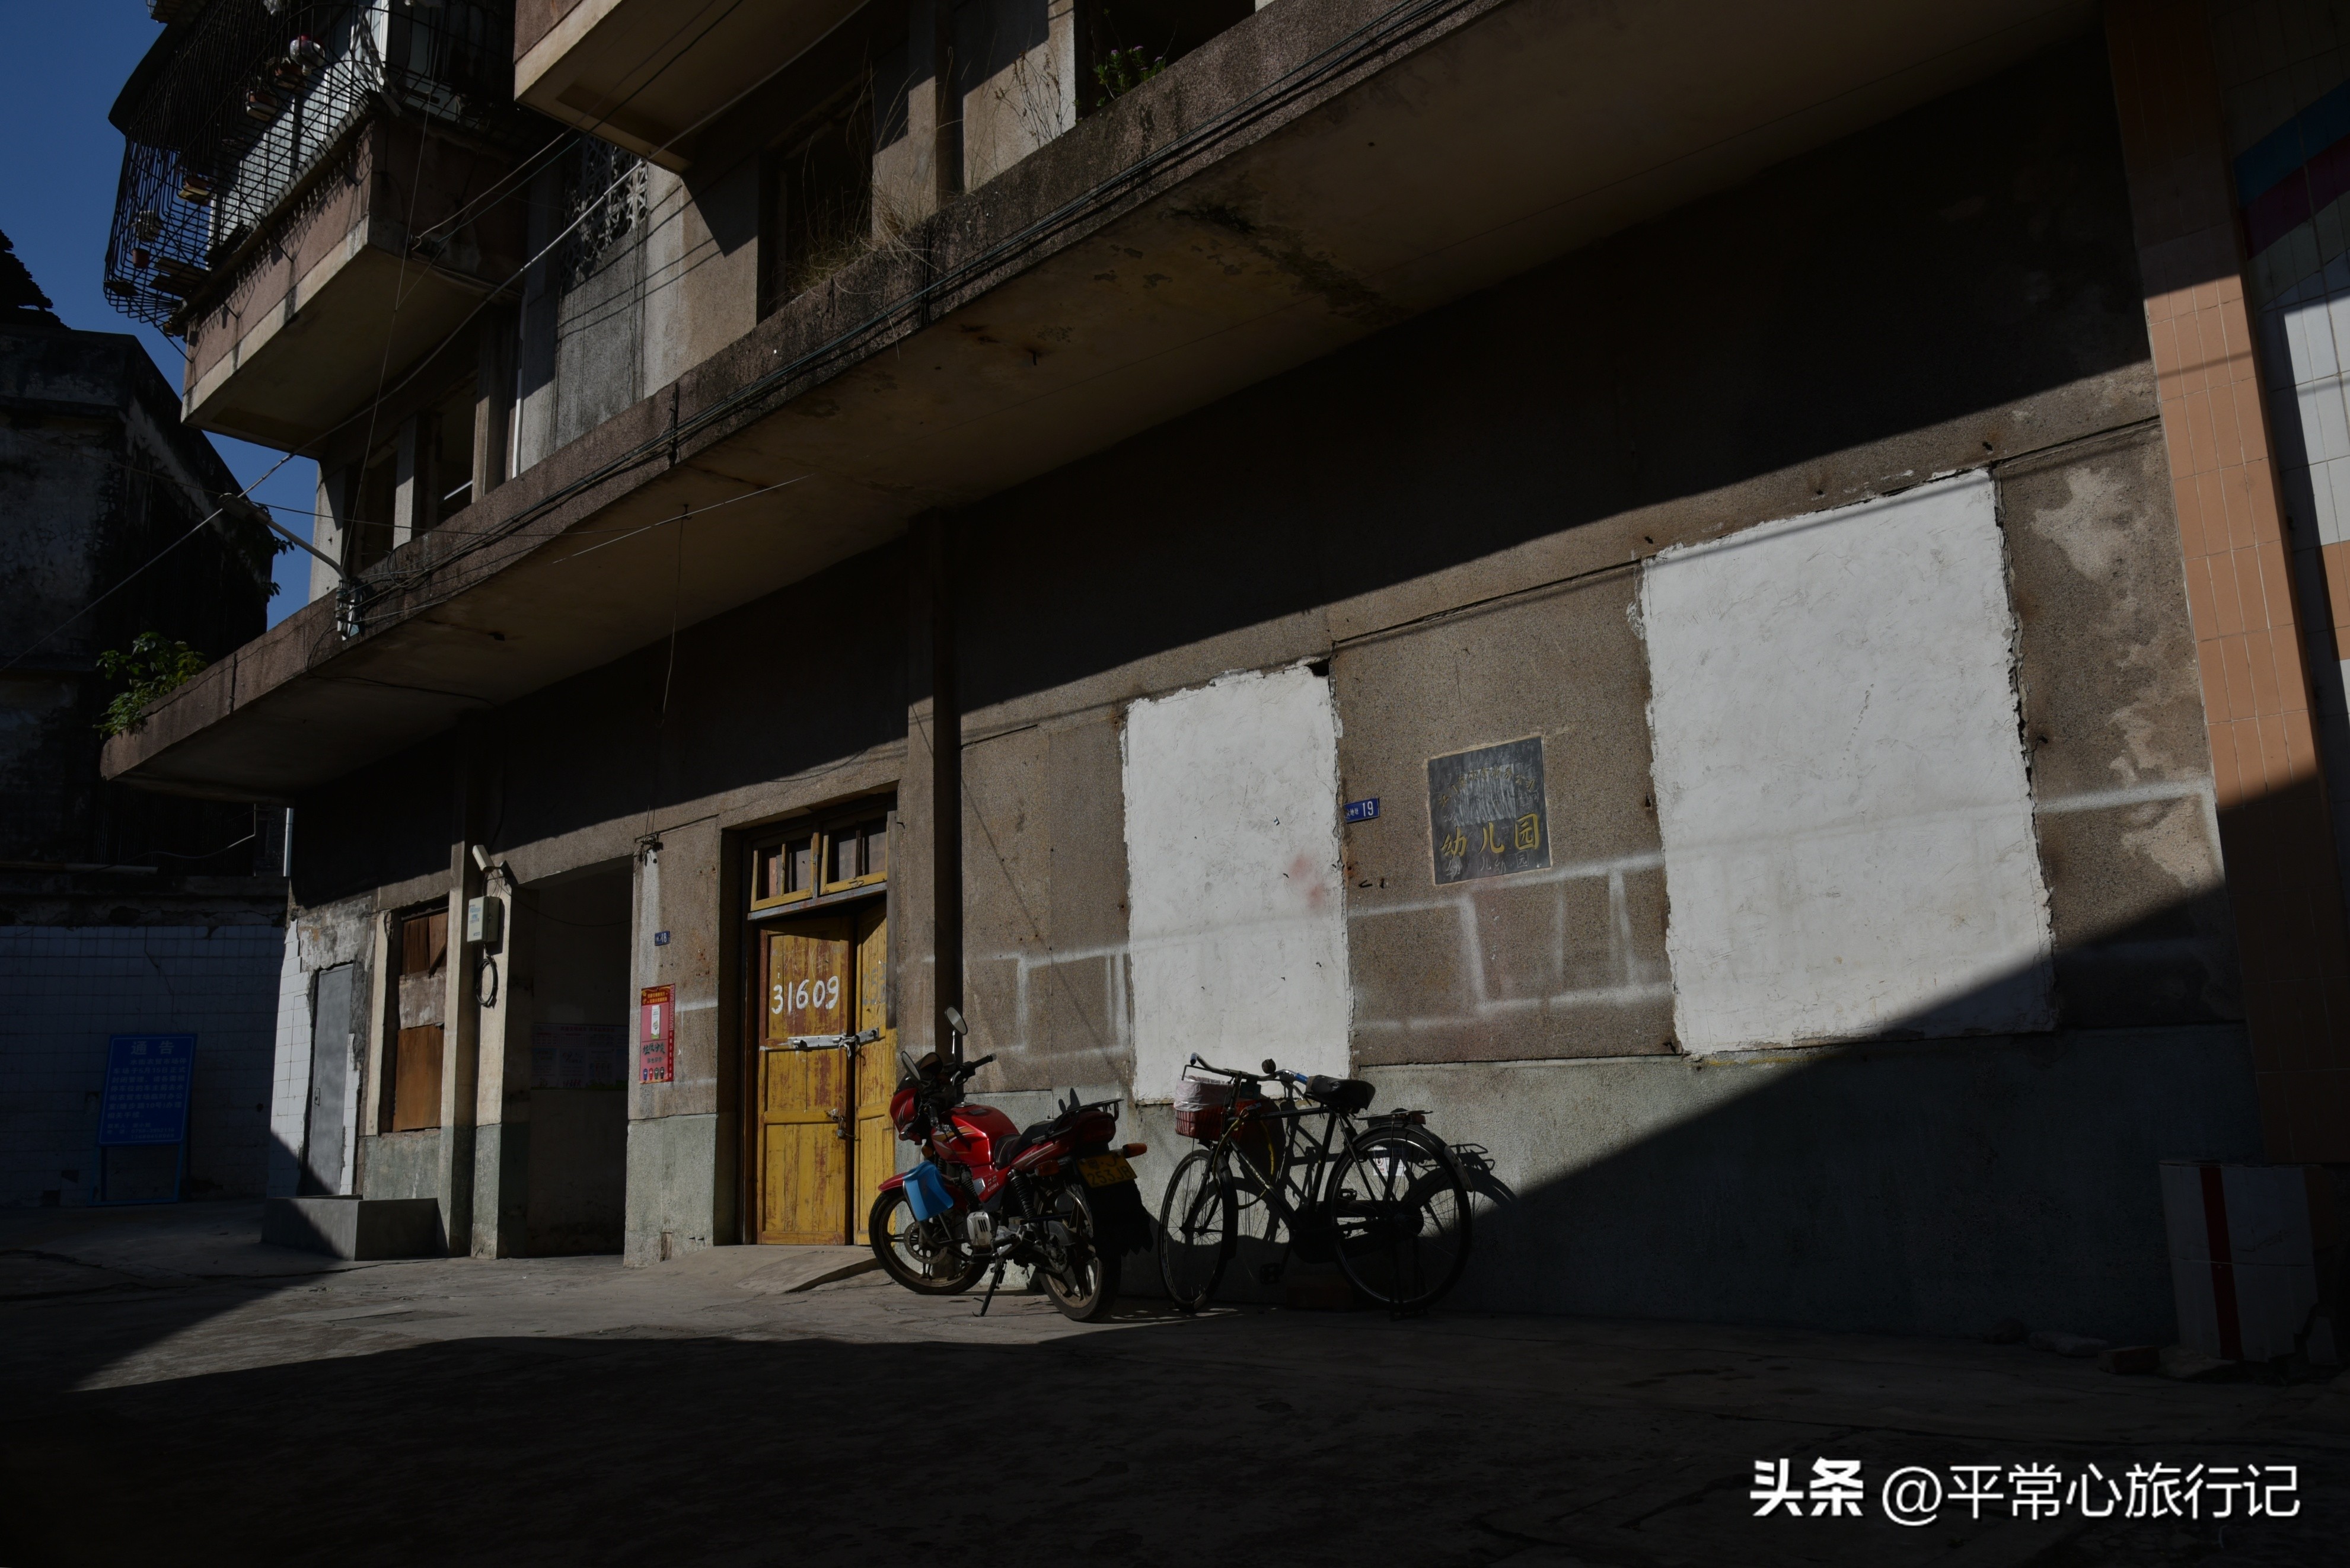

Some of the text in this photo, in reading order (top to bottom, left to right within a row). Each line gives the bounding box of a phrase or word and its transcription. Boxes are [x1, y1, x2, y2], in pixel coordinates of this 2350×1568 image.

[1362, 800, 1374, 817] 19
[1440, 812, 1541, 860] 幼儿园
[661, 933, 667, 943] 18
[770, 975, 840, 1015] 31609
[130, 1040, 174, 1055] 通告
[1087, 1165, 1133, 1185] 253JB
